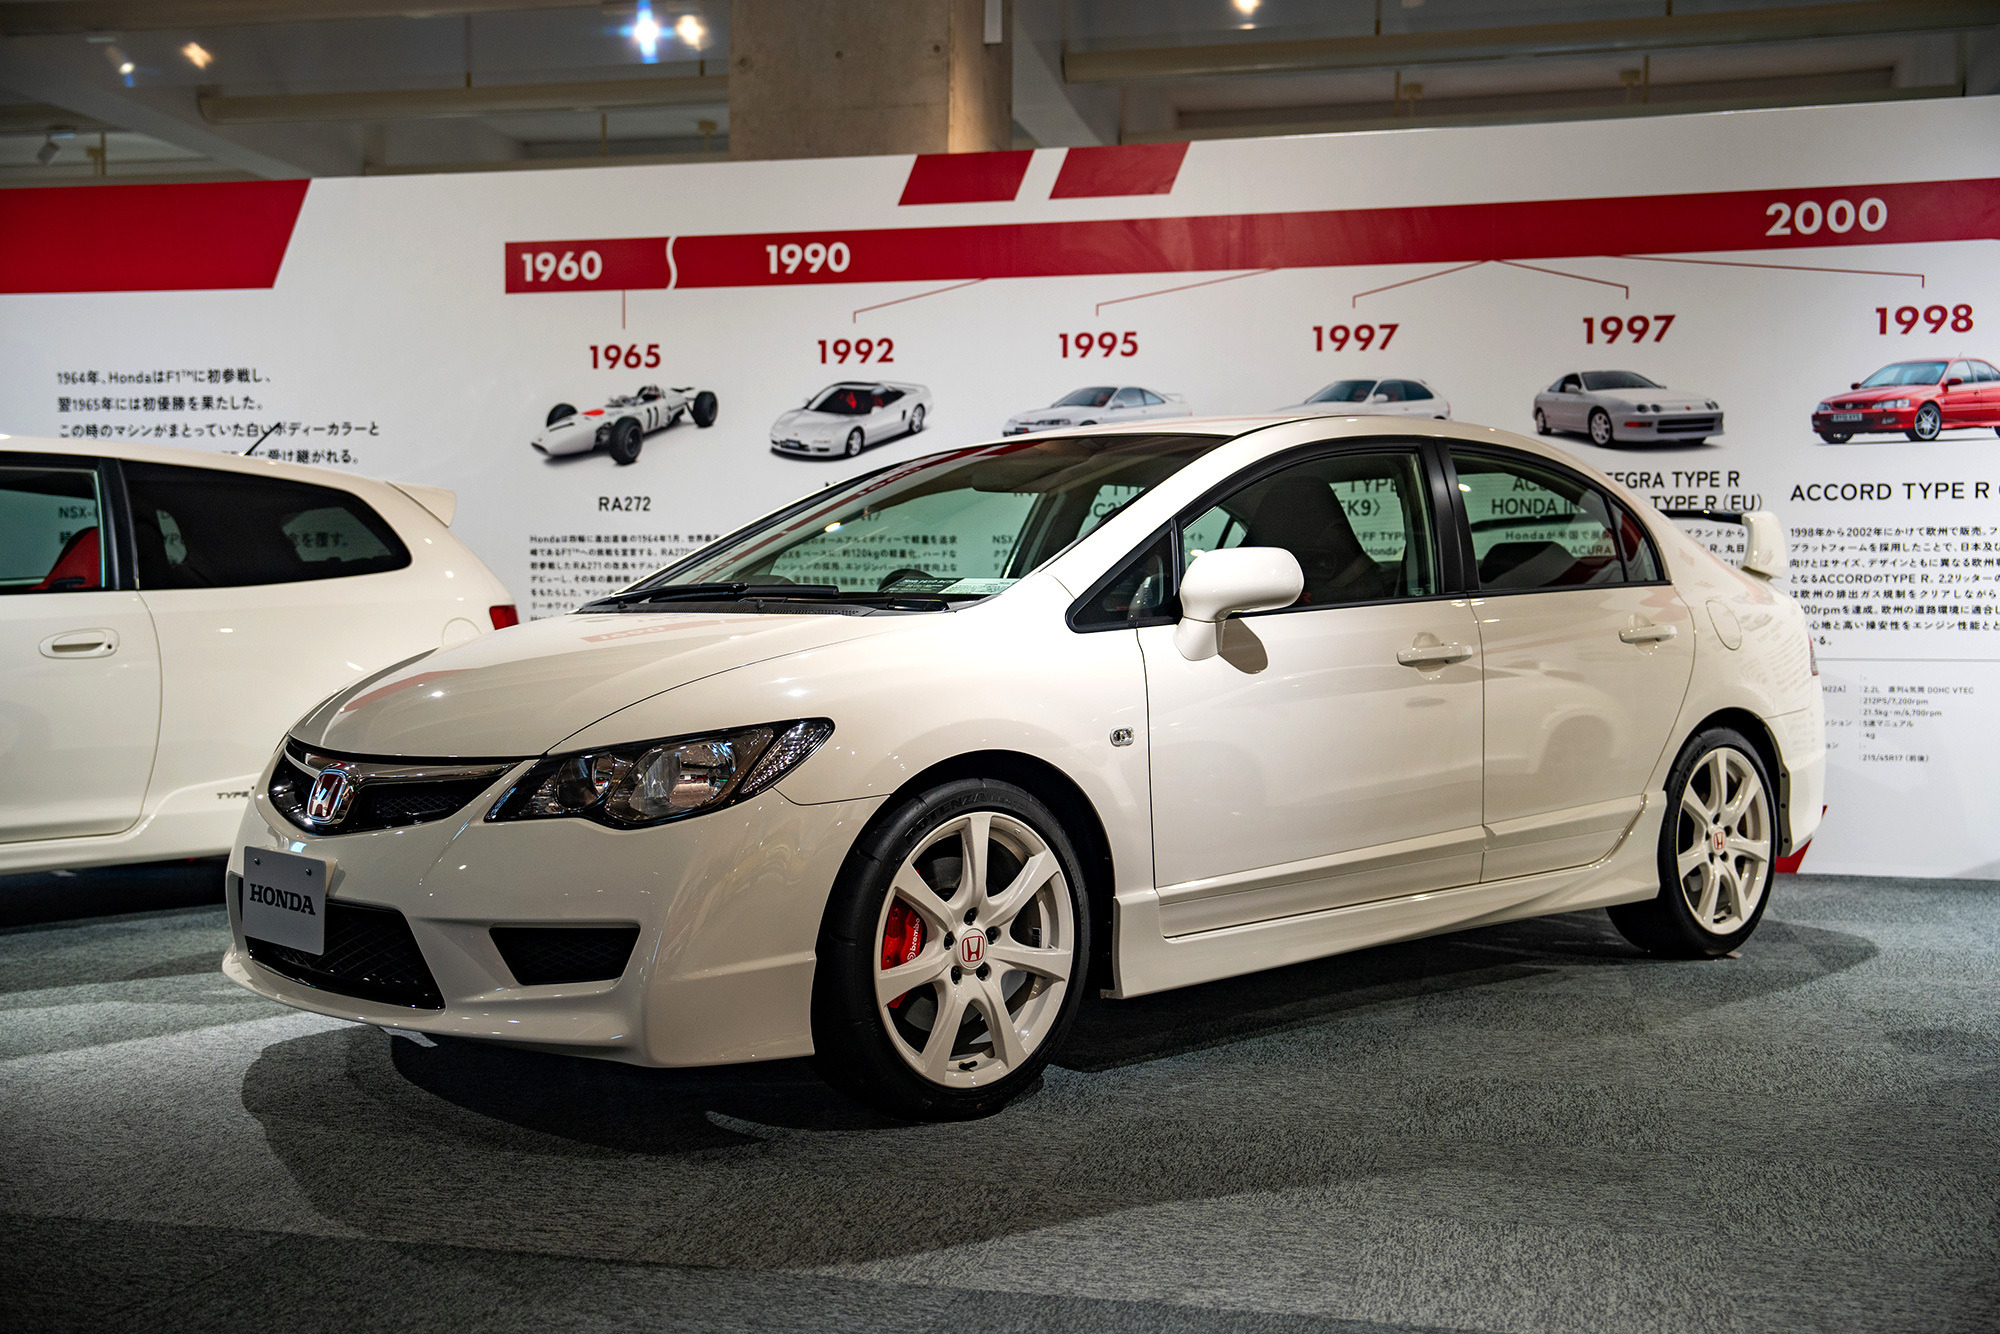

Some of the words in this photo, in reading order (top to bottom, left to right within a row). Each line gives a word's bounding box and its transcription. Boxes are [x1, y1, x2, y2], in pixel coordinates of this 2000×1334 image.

[1765, 197, 1888, 236] 2000
[521, 249, 603, 282] 1960
[766, 241, 851, 275] 1990
[1582, 314, 1676, 344] 1997
[1875, 304, 1974, 336] 1998
[817, 337, 894, 365] 1992
[1058, 331, 1139, 359] 1995
[1312, 323, 1399, 352] 1997
[589, 343, 661, 370] 1965
[57, 395, 263, 412] 翌1965年には初優勝を果たした。
[1604, 470, 1665, 489] EGRA
[1671, 470, 1720, 488] TYPE
[1728, 470, 1741, 488] R
[1790, 483, 1893, 502] ACCORD
[1902, 482, 1966, 500] TYPE
[1975, 481, 1991, 500] R
[58, 506, 98, 519] NSX-
[598, 496, 652, 512] RA272
[1491, 498, 1557, 516] HONDA
[1704, 494, 1718, 510] R
[1801, 604, 2000, 617] 00rpmを達成。欧州の道路環境に適合し
[1927, 686, 1951, 695] DOHC
[1952, 686, 1976, 695] VTEC
[216, 791, 250, 800] TYPE
[249, 883, 316, 916] HONDA
[909, 917, 921, 952] brembo
